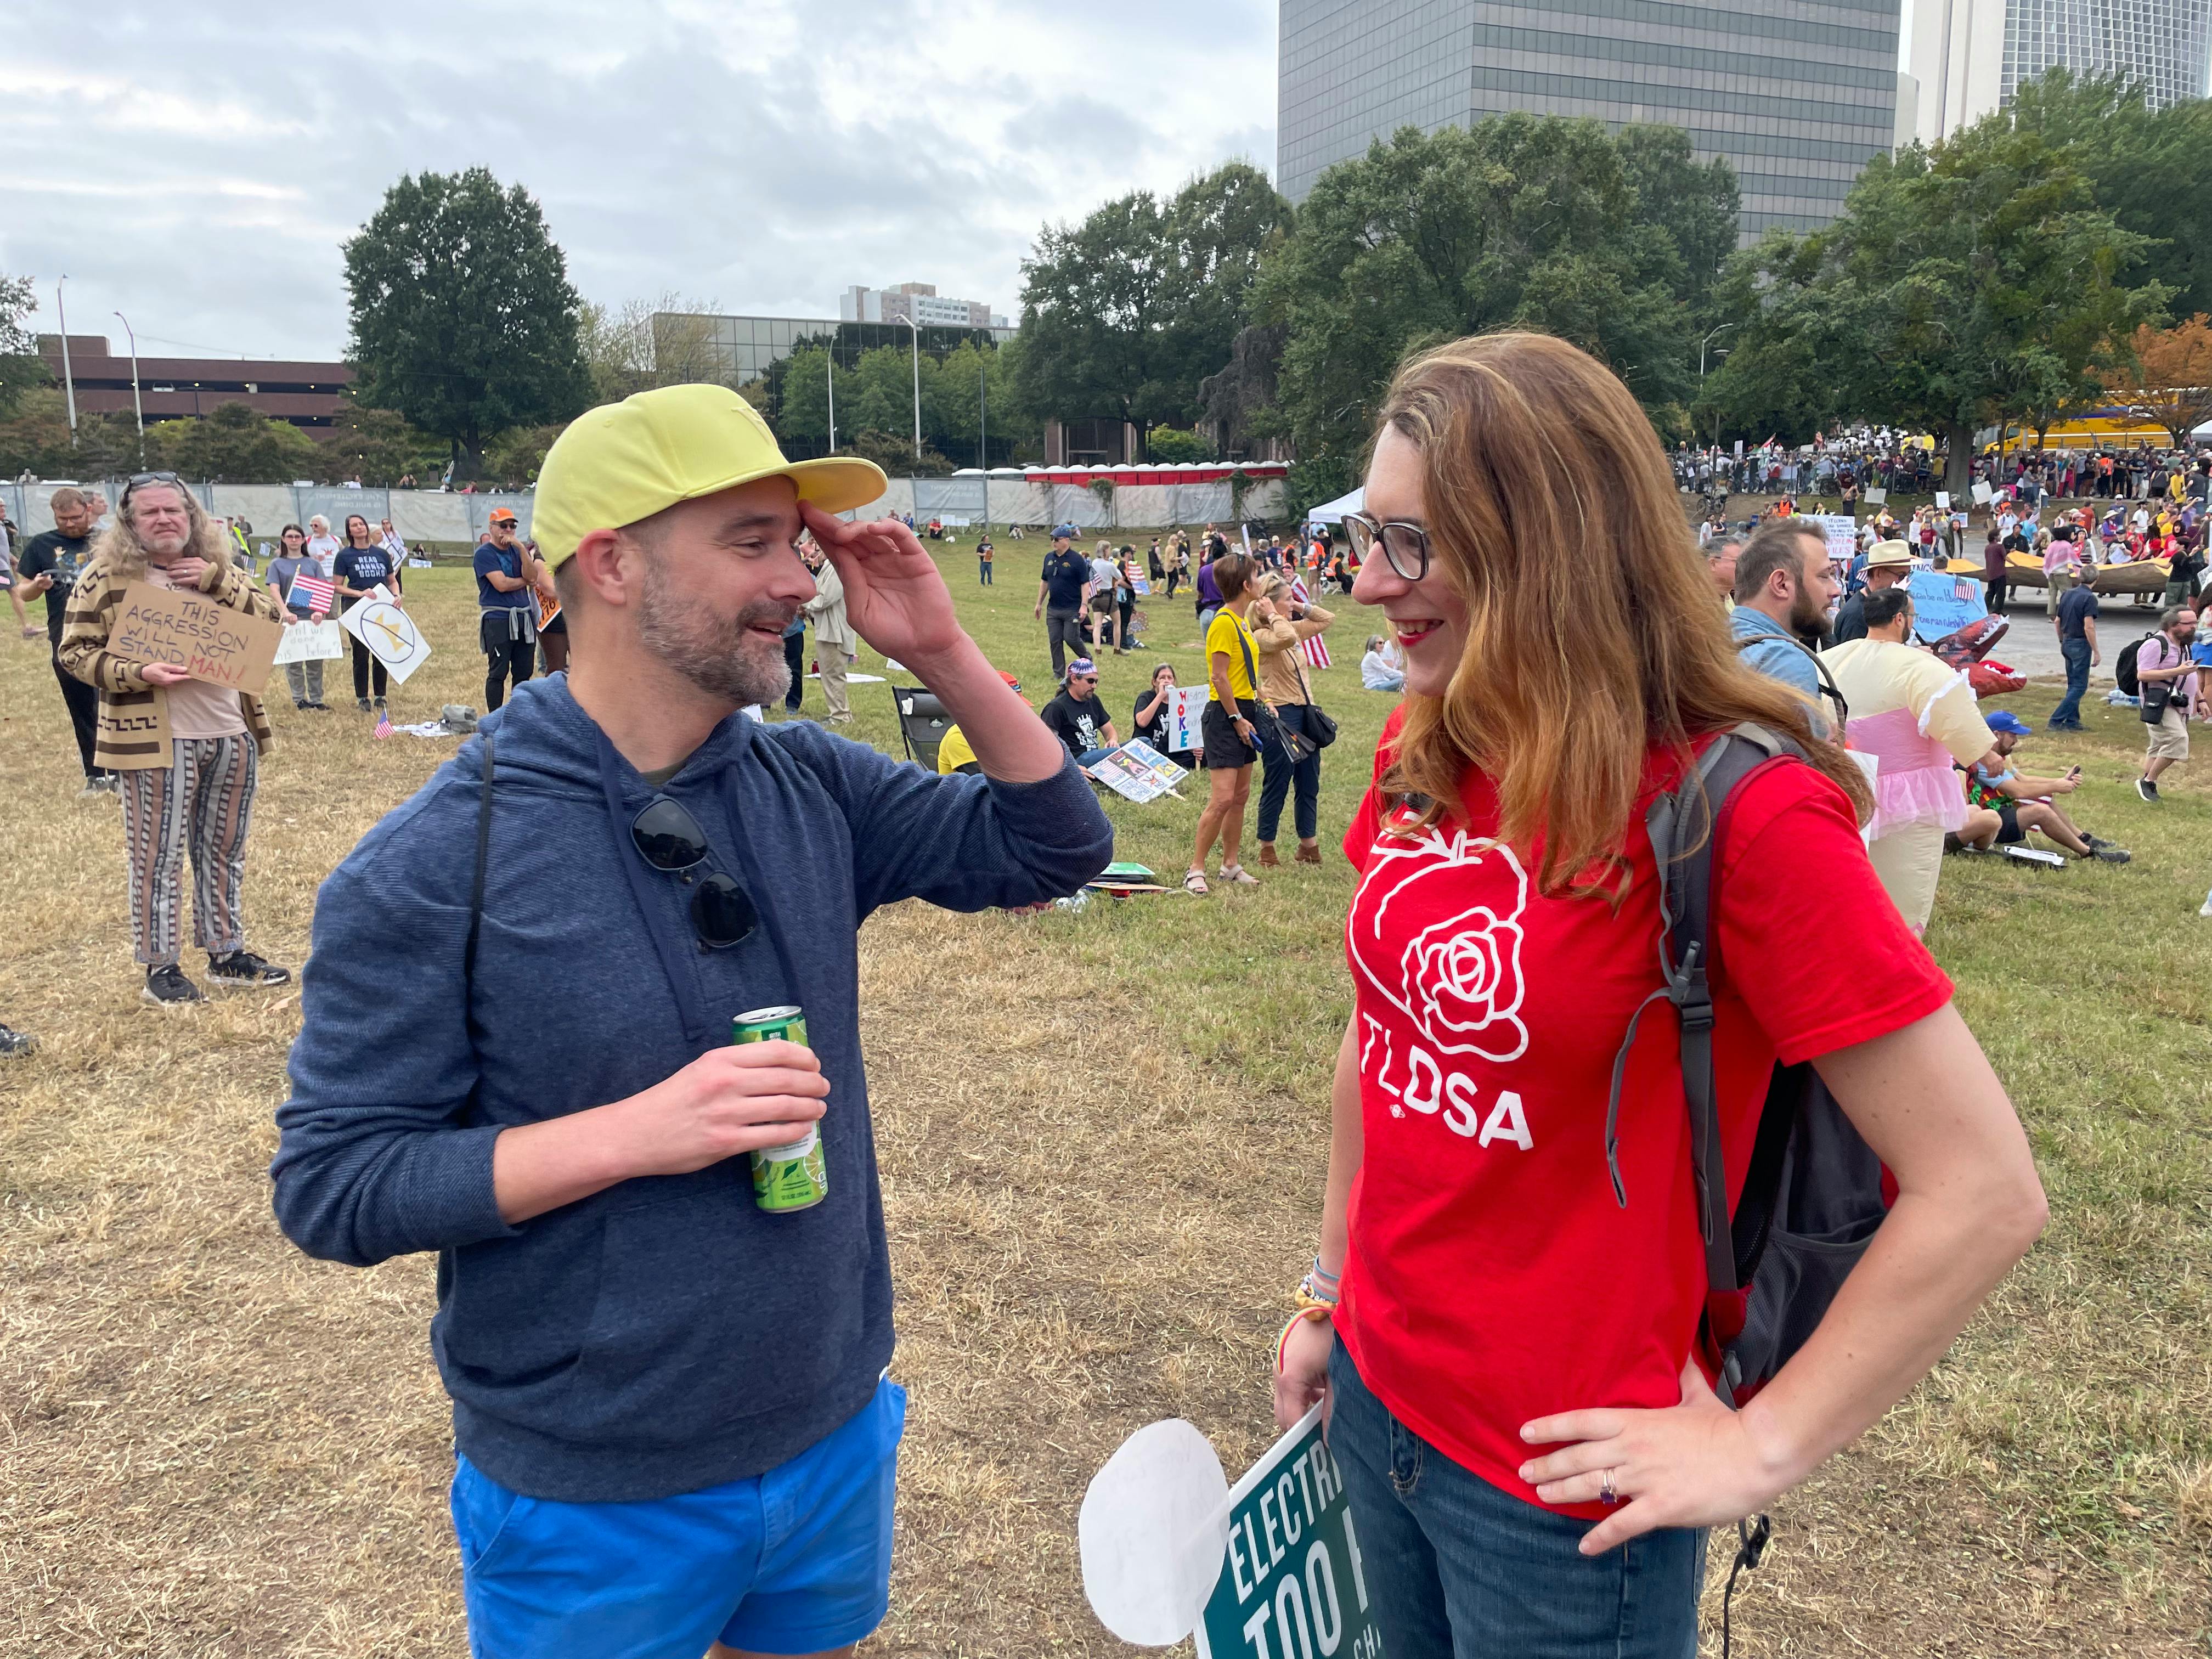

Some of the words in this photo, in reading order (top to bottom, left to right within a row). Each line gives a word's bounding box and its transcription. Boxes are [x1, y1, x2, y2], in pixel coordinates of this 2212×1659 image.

[354, 562, 386, 571] BANNED
[358, 569, 387, 578] BOOKS
[126, 604, 249, 651] AGGRESSION
[182, 601, 219, 626] THIS
[126, 624, 177, 646] WILL
[194, 641, 235, 663] NOT
[119, 636, 185, 664] STAND
[189, 654, 246, 684] MAN!
[1107, 771, 1126, 785] TRUMP
[1243, 1539, 1342, 1659] TOO
